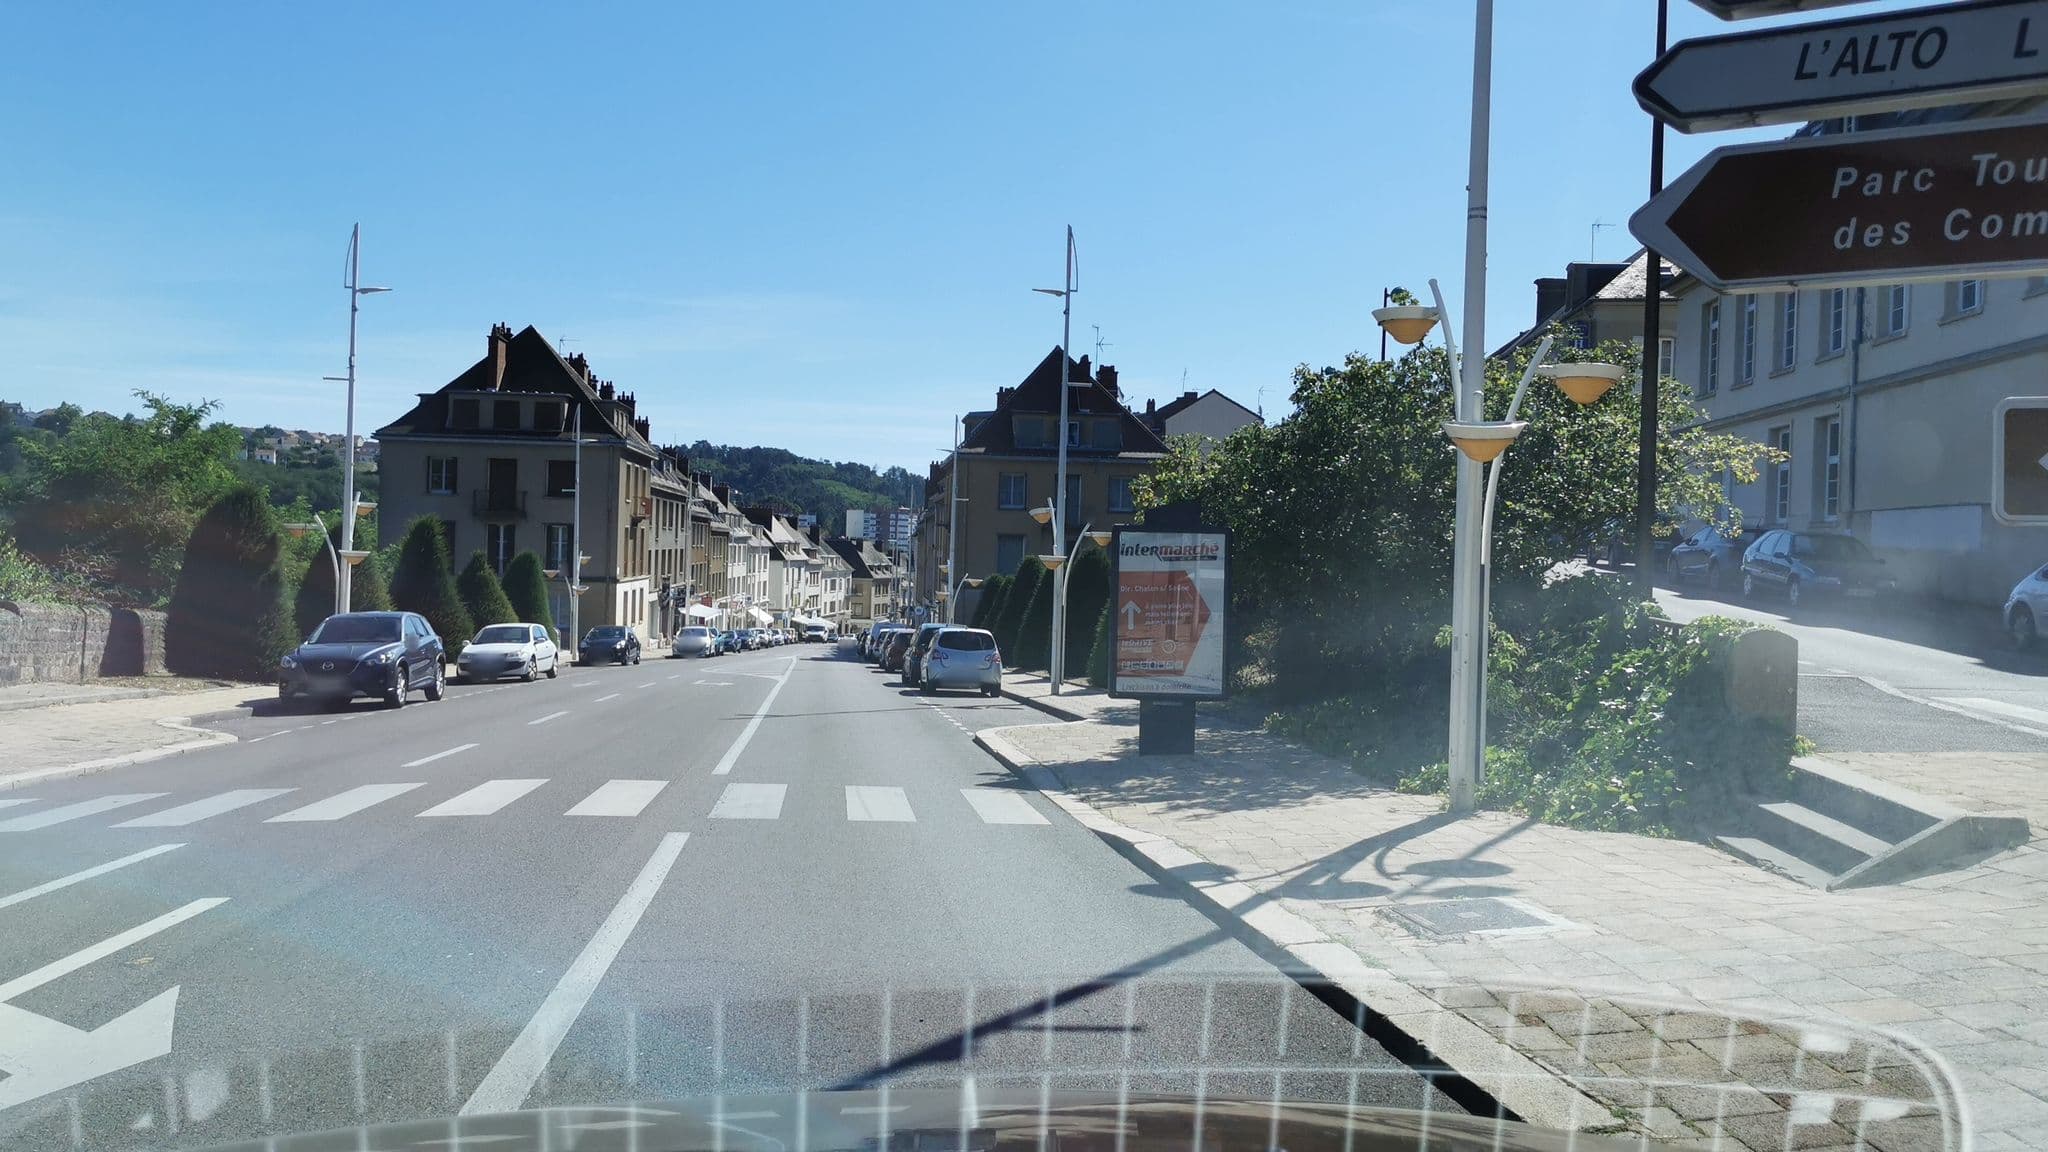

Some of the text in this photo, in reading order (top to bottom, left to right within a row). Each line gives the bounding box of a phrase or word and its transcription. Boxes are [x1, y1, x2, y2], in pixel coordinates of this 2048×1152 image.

[1794, 26, 1948, 80] L'ALTO
[1831, 152, 2048, 199] Parc Tou
[1833, 208, 2048, 250] des Com
